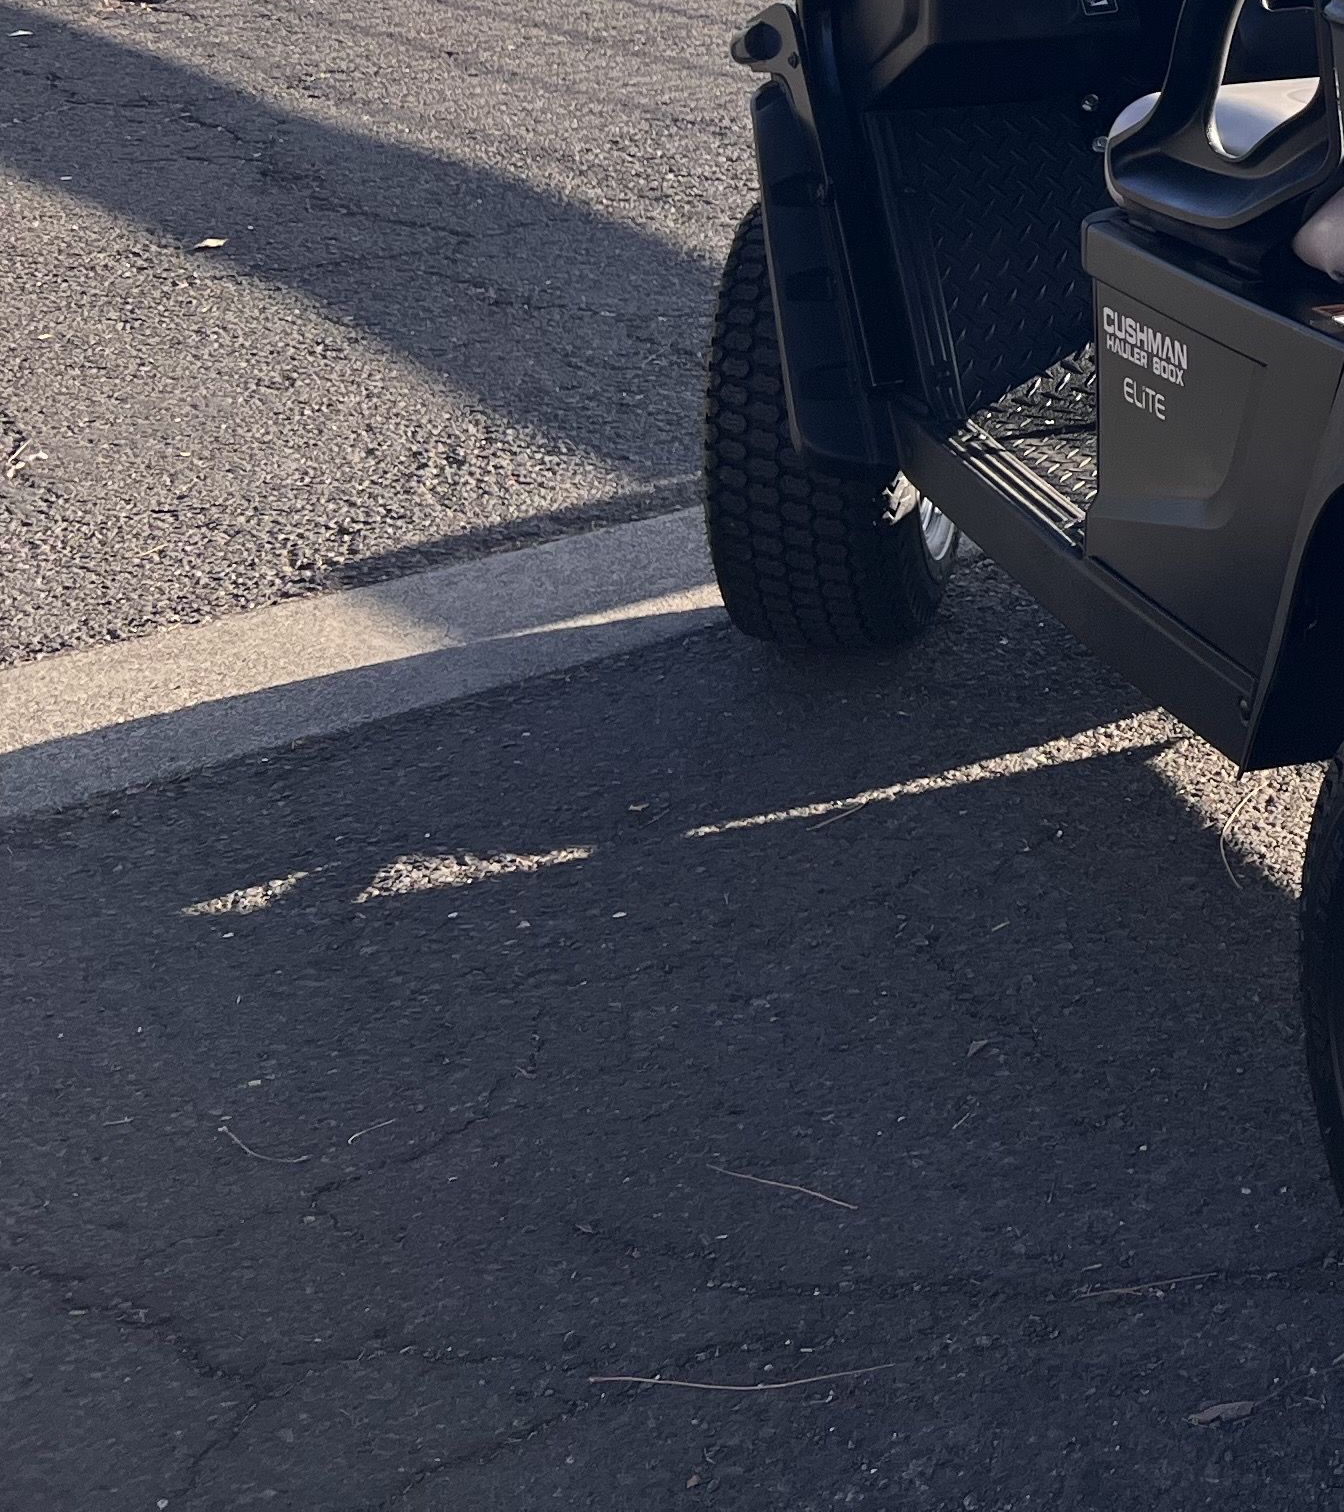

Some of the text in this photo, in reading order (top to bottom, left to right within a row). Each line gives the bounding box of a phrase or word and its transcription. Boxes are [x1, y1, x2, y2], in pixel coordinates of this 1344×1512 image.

[1103, 306, 1188, 370] CUSHMAN
[1106, 334, 1185, 387] HAULER 800X
